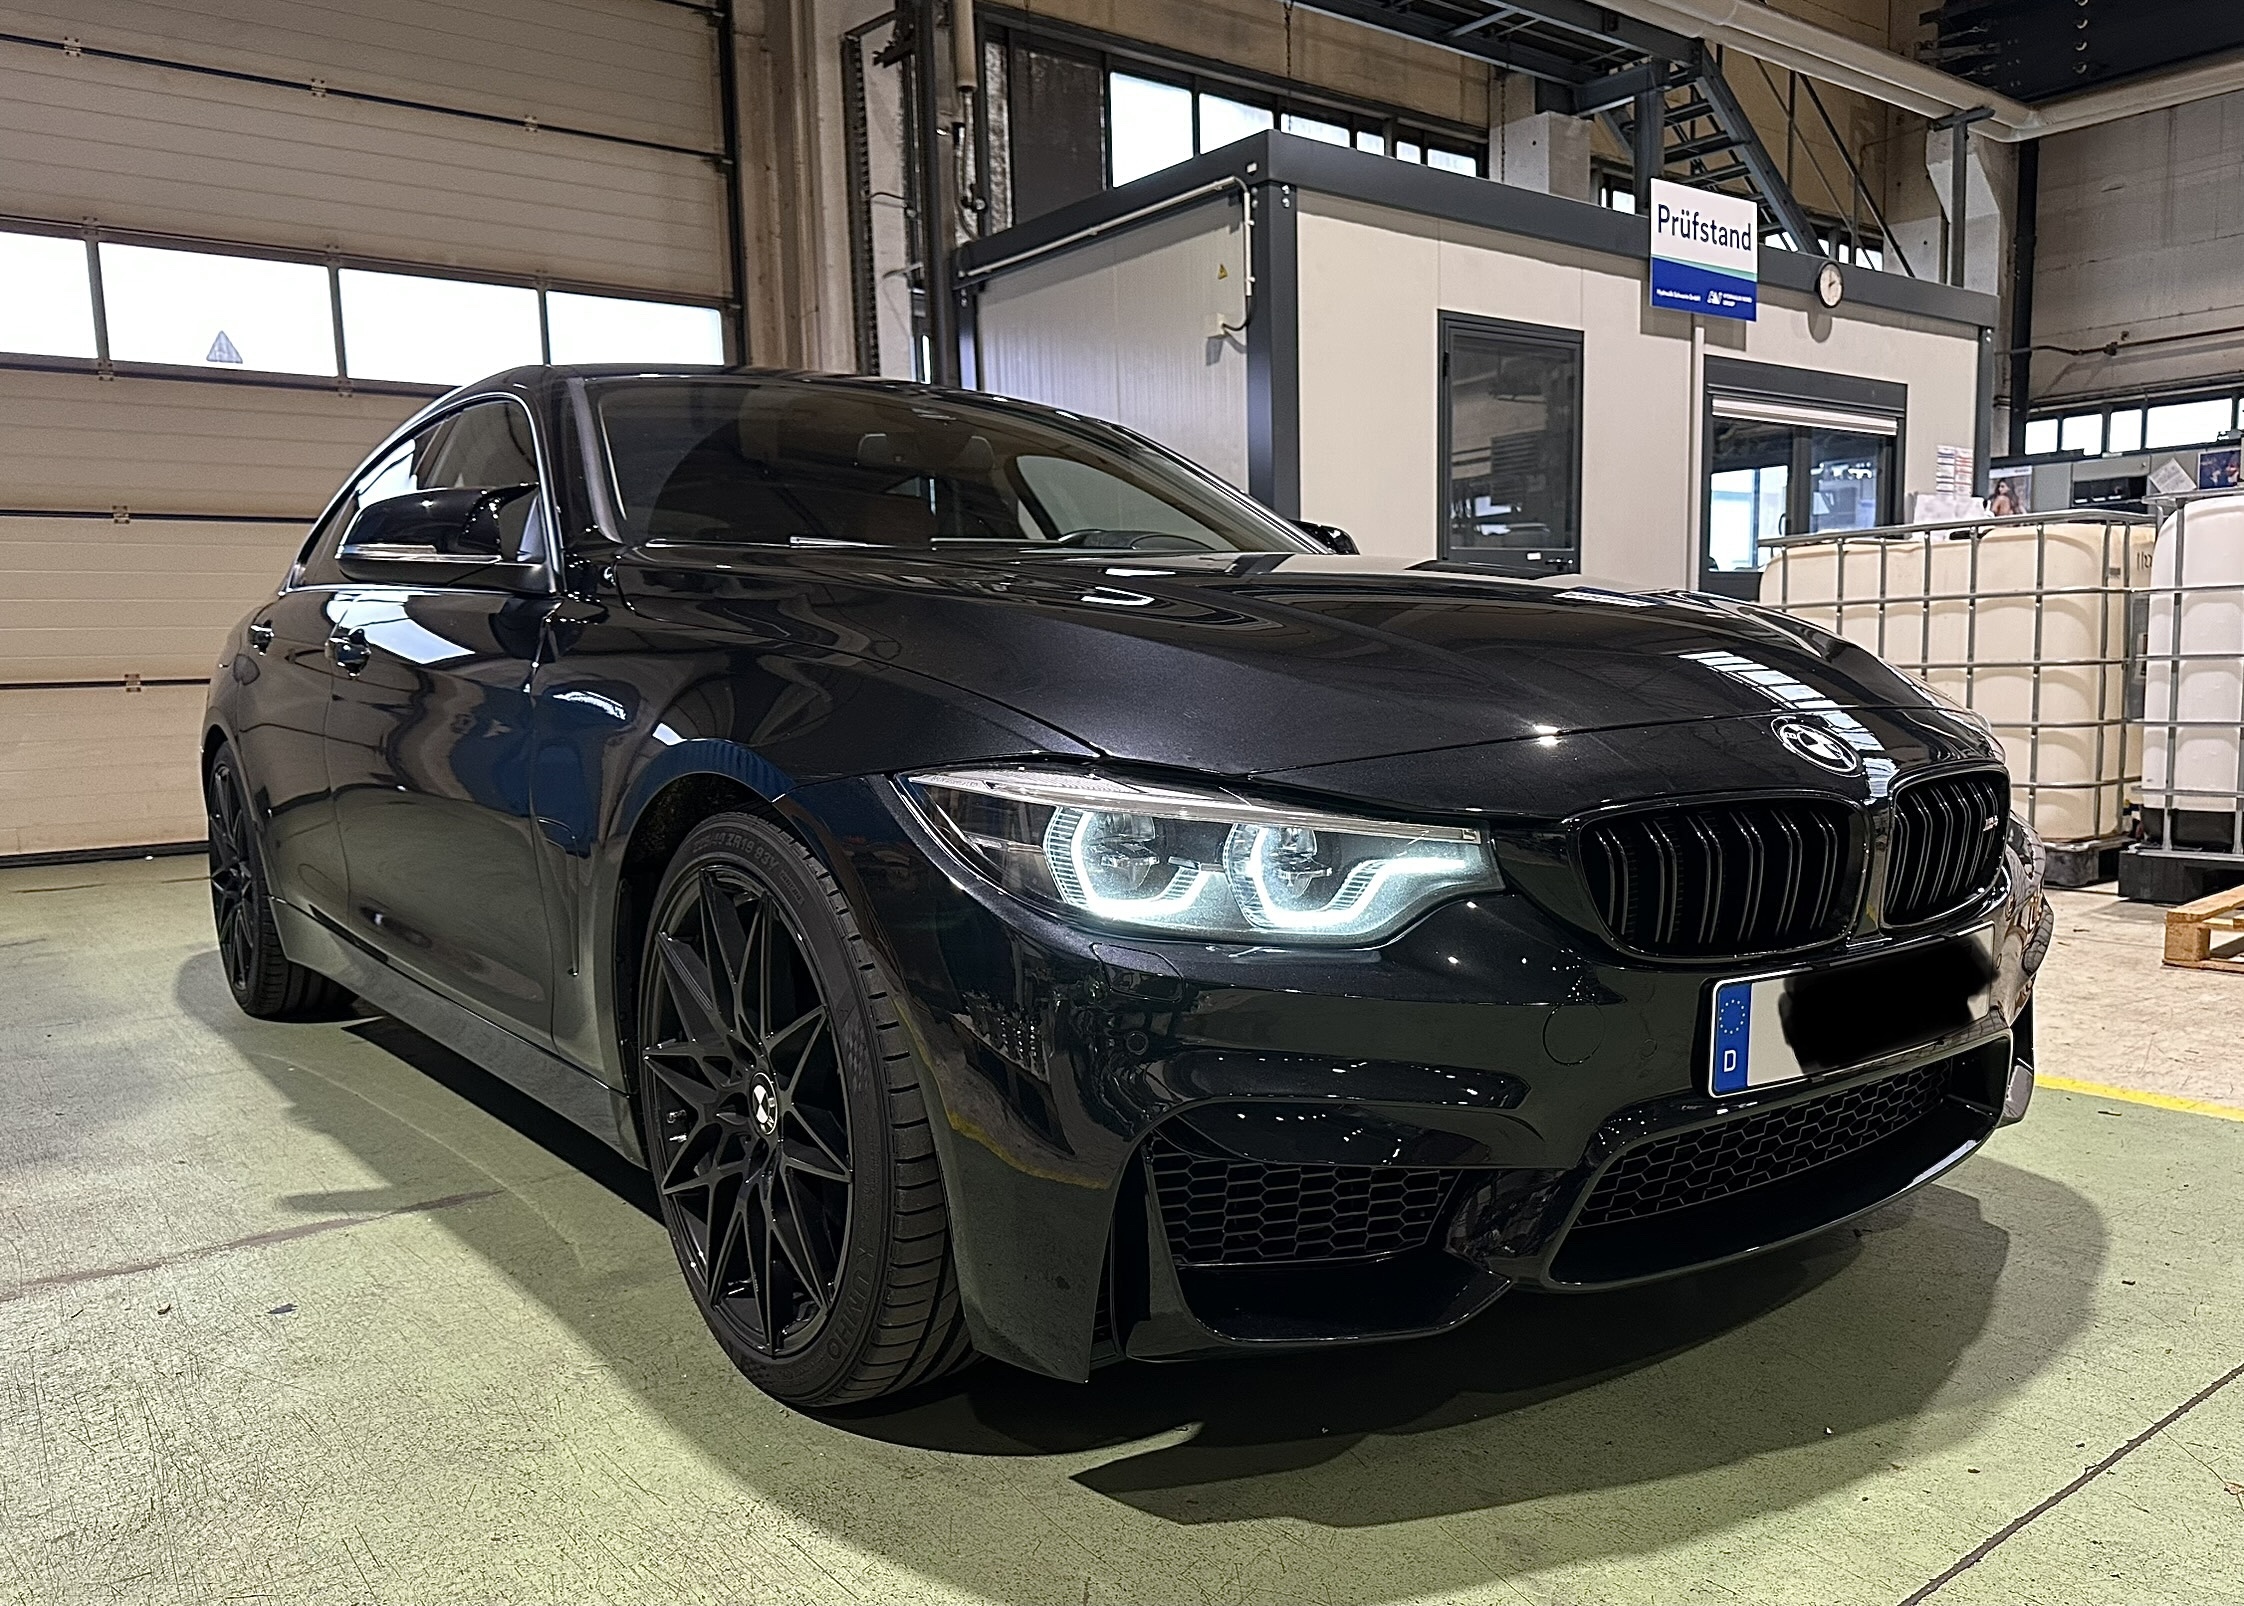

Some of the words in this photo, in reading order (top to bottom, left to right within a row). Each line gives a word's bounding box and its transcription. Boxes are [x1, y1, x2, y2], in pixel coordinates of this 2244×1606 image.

[1658, 204, 1752, 251] Prüfstand
[1723, 1049, 1736, 1073] D
[827, 1246, 875, 1361] KUMHO
